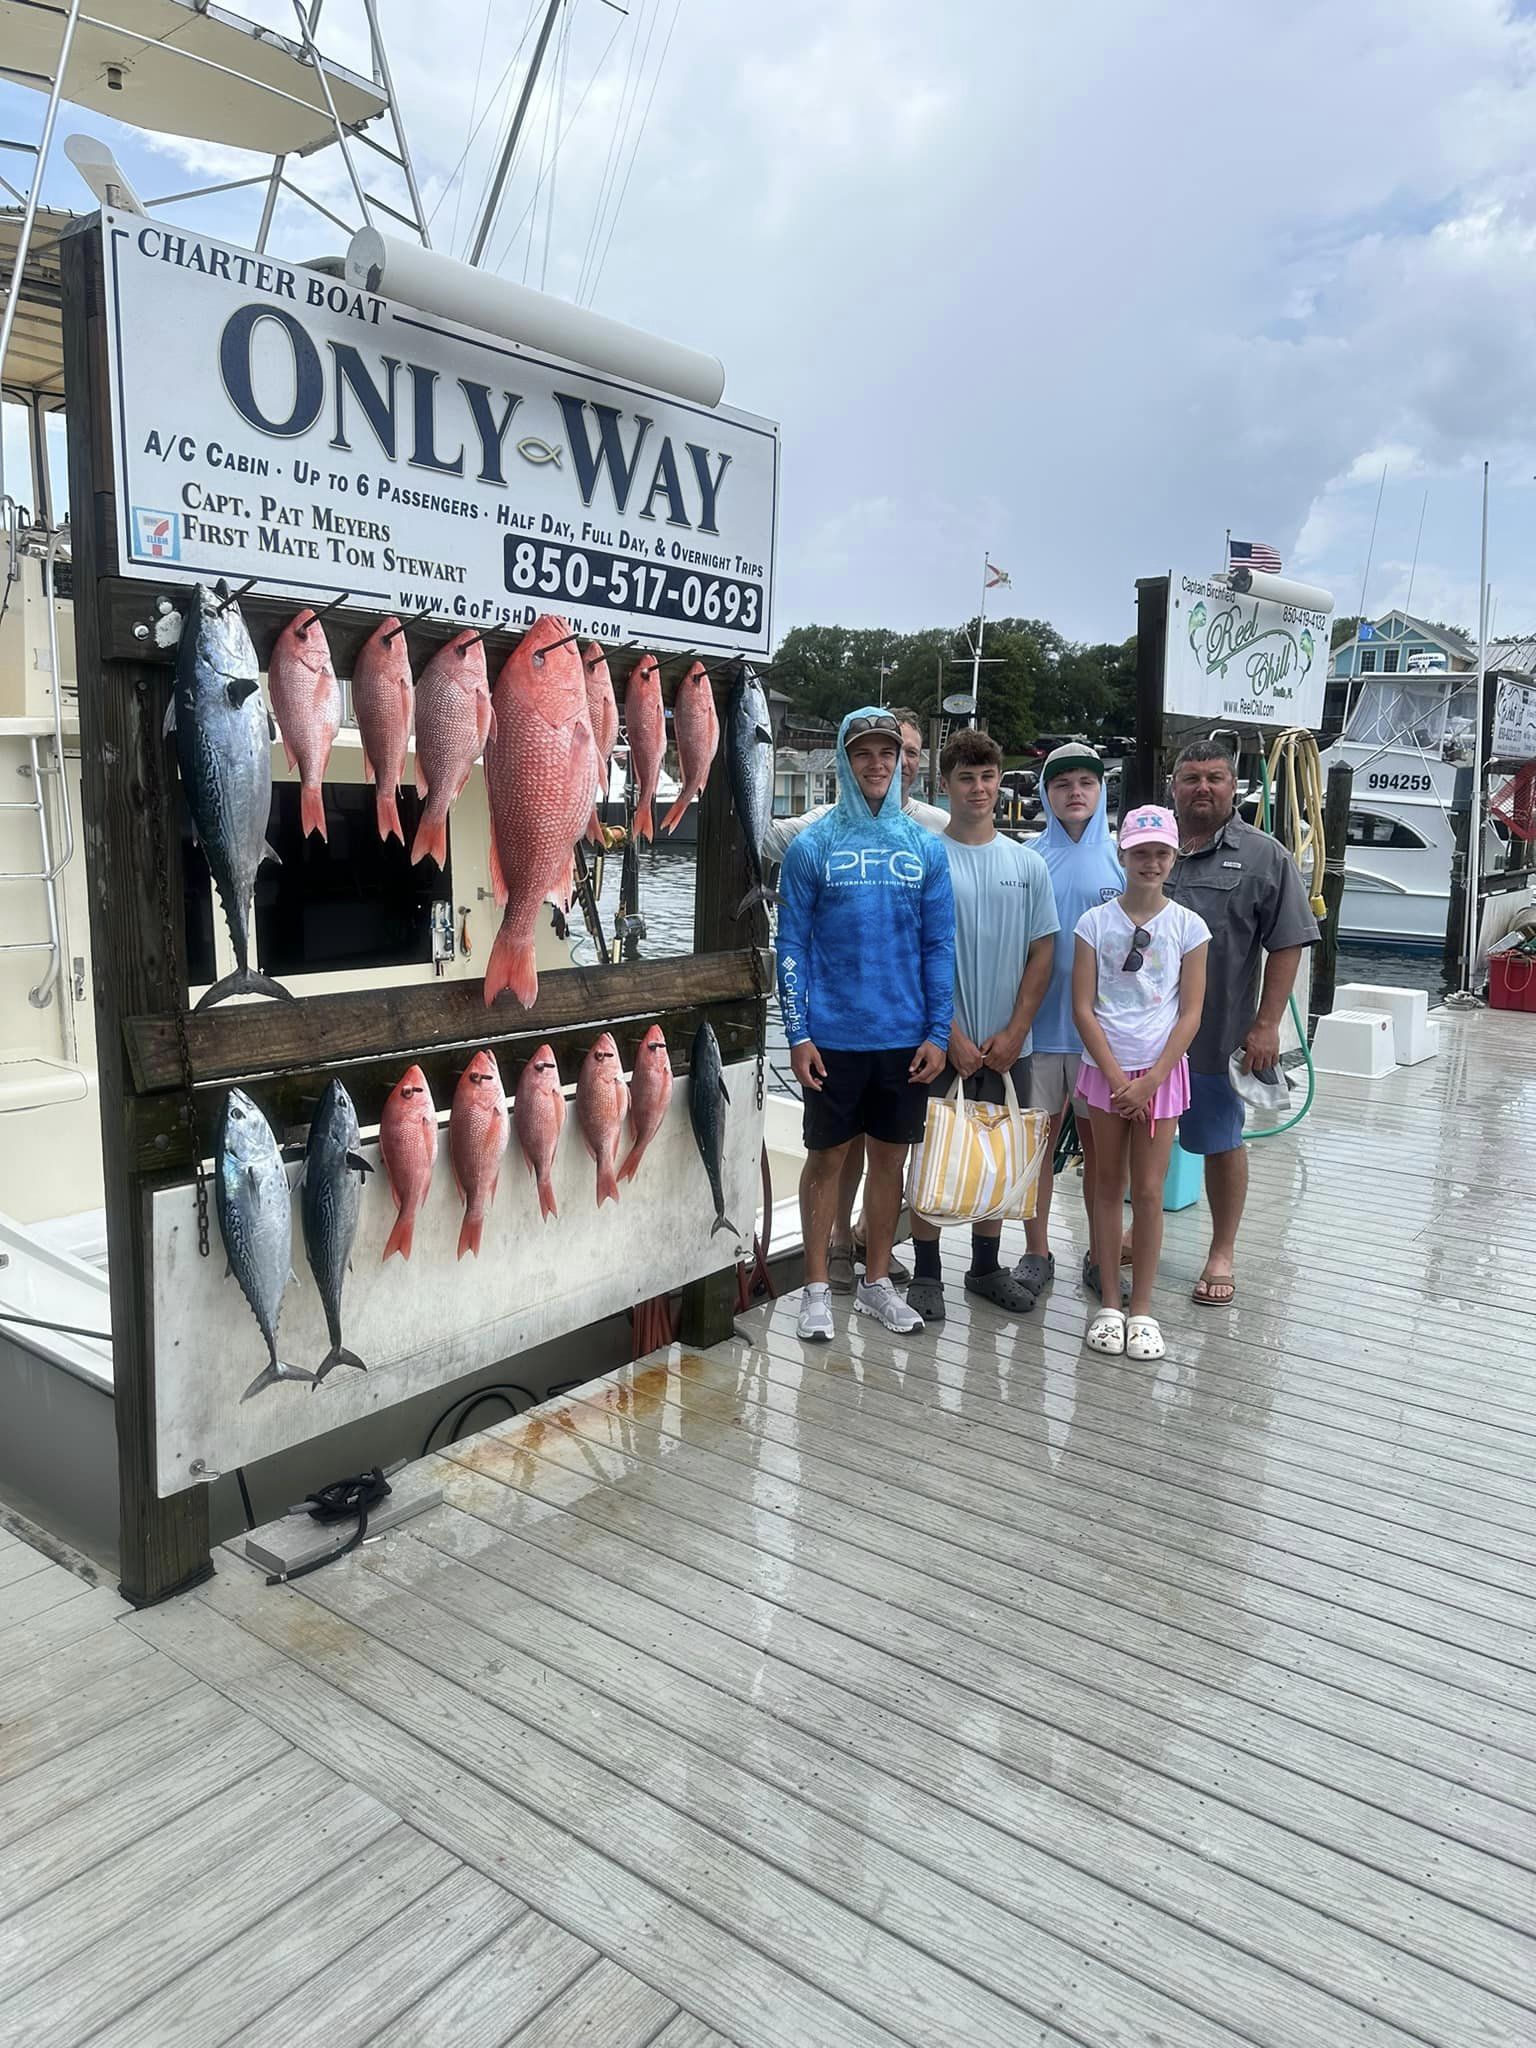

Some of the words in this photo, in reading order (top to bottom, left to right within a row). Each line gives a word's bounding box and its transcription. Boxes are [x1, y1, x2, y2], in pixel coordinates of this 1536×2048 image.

[137, 228, 297, 300] CHARTER
[306, 278, 387, 325] BOAT
[218, 302, 524, 488] ONLY
[553, 391, 734, 536] WAY
[143, 429, 197, 463] A/C
[205, 441, 269, 477] CABIN
[293, 459, 321, 486] UP
[328, 473, 348, 493] TO
[356, 474, 370, 497] 6
[377, 477, 479, 520] PASSENGERS
[496, 503, 536, 530] HALF
[541, 513, 575, 543] DAY,
[581, 522, 613, 547] FULL
[618, 530, 649, 557] DAY,
[654, 537, 666, 557] &
[671, 541, 731, 571] OVERNIGHT
[735, 555, 764, 578] TRIPS
[181, 481, 251, 519] CAPT.
[260, 495, 304, 527] PAT
[311, 505, 391, 542] MEYERS
[181, 512, 249, 548] FIRST
[258, 525, 320, 560] MATE
[327, 537, 375, 568] TOM
[383, 548, 467, 584] STEWART
[399, 591, 622, 638] WWW.GOFISHDIN.COM
[511, 542, 759, 628] 850-517-0693
[1182, 576, 1206, 596] Captain
[1206, 601, 1260, 664] Reel
[1246, 641, 1292, 696] Chill
[1368, 773, 1432, 791] 994259
[1136, 815, 1163, 828] TX
[825, 848, 923, 882] PFG
[784, 971, 802, 1033] Columbia
